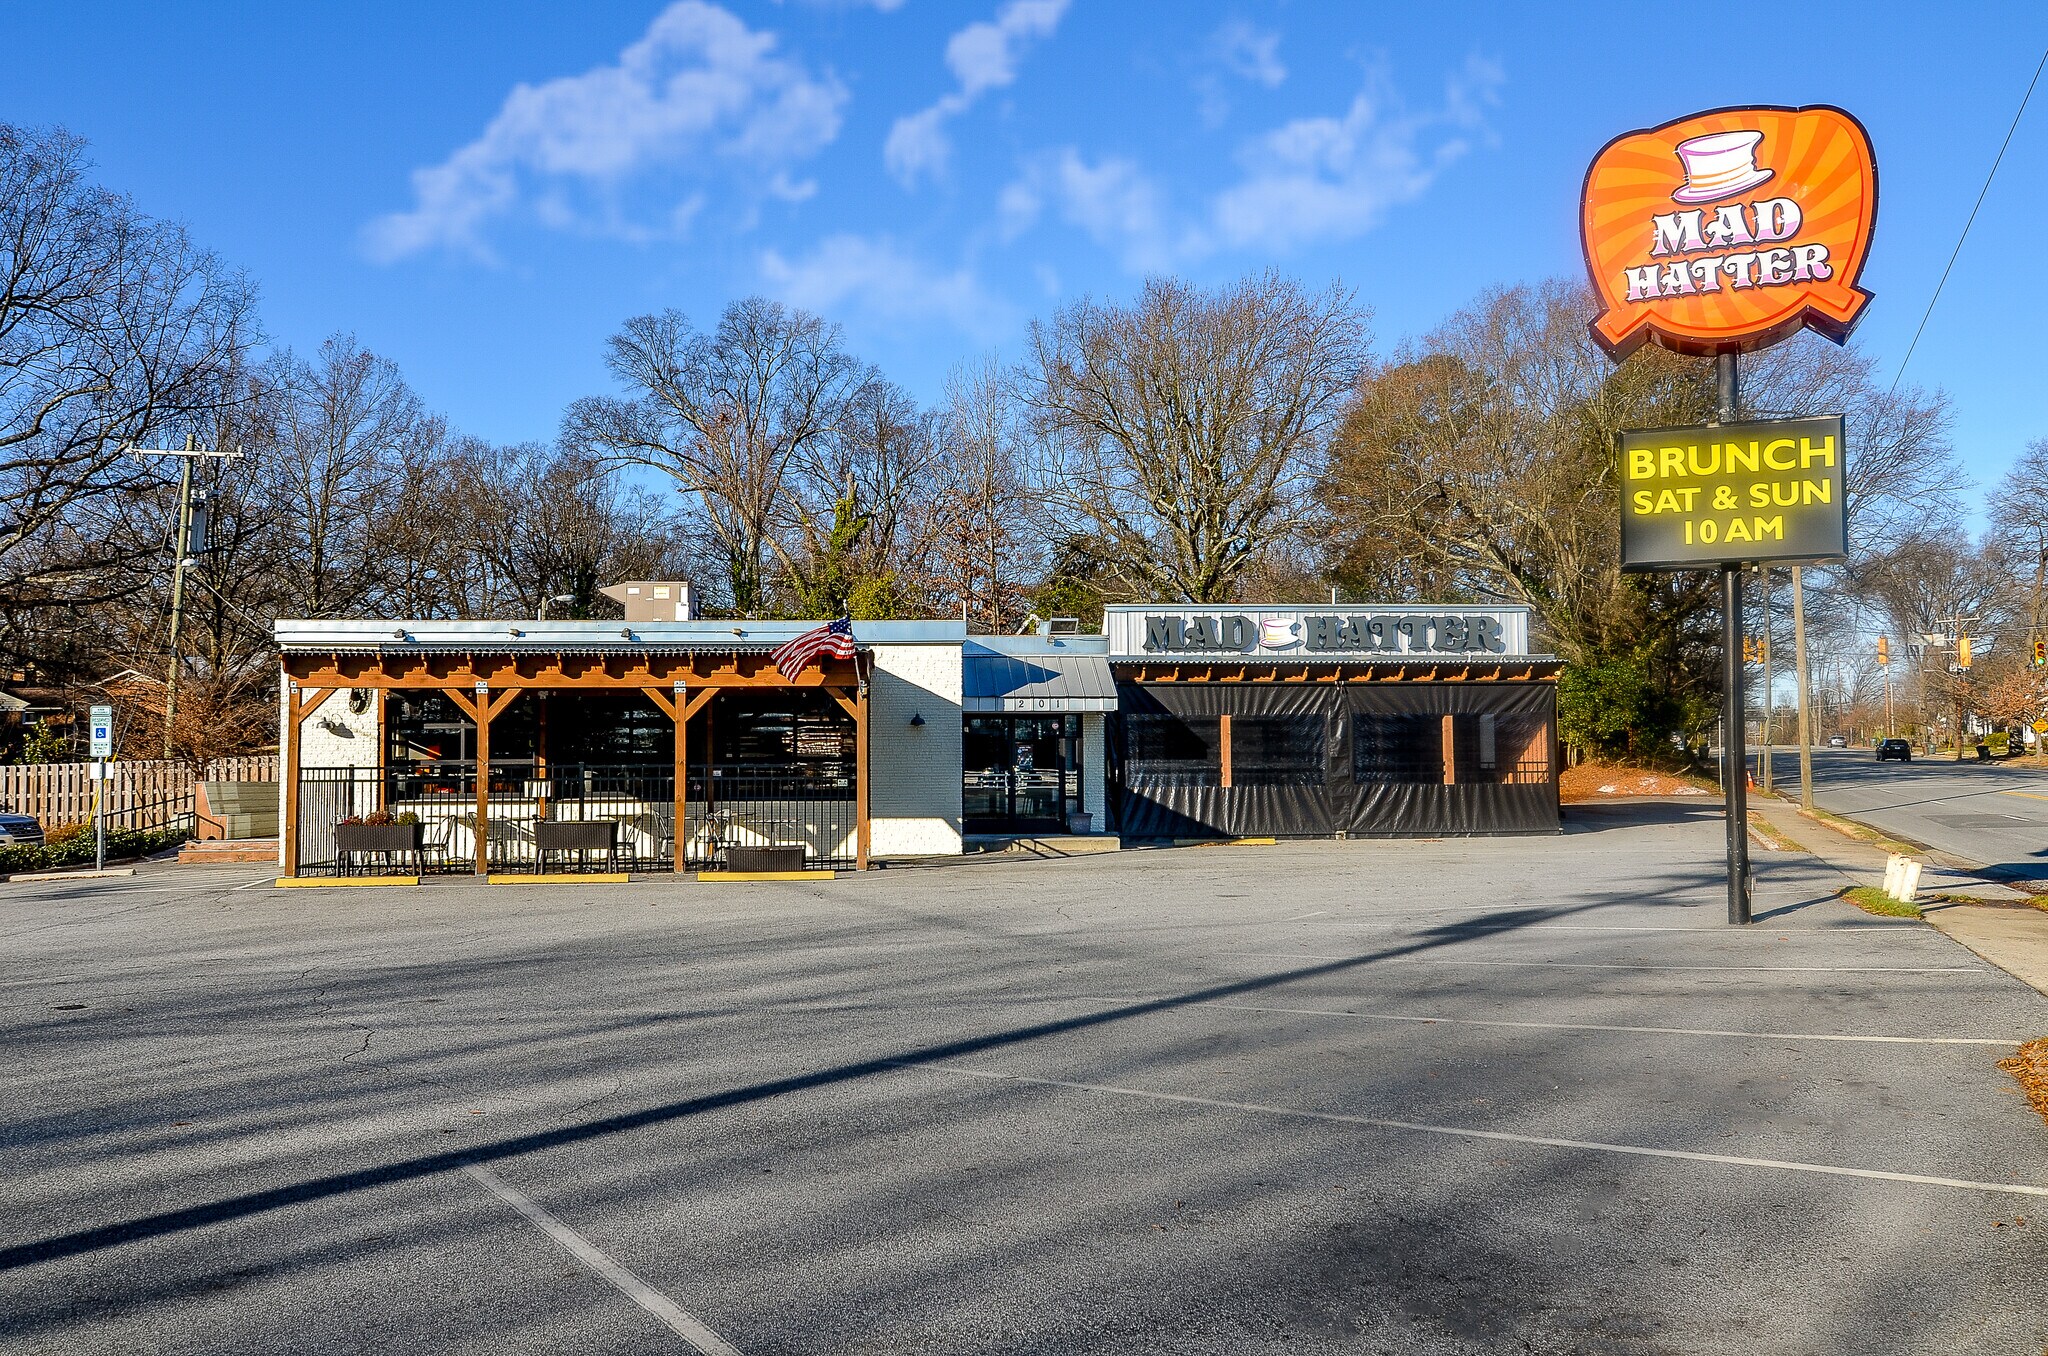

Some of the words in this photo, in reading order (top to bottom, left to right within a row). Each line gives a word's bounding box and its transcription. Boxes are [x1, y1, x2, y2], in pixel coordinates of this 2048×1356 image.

[1649, 197, 1803, 259] MAD
[1624, 244, 1833, 303] HATTER
[1628, 435, 1836, 480] BRUNCH
[1633, 487, 1702, 515] SAT
[1711, 485, 1739, 511] &
[1749, 478, 1832, 508] SUN
[1142, 615, 1257, 653] MAD
[1304, 615, 1505, 653] HATTER
